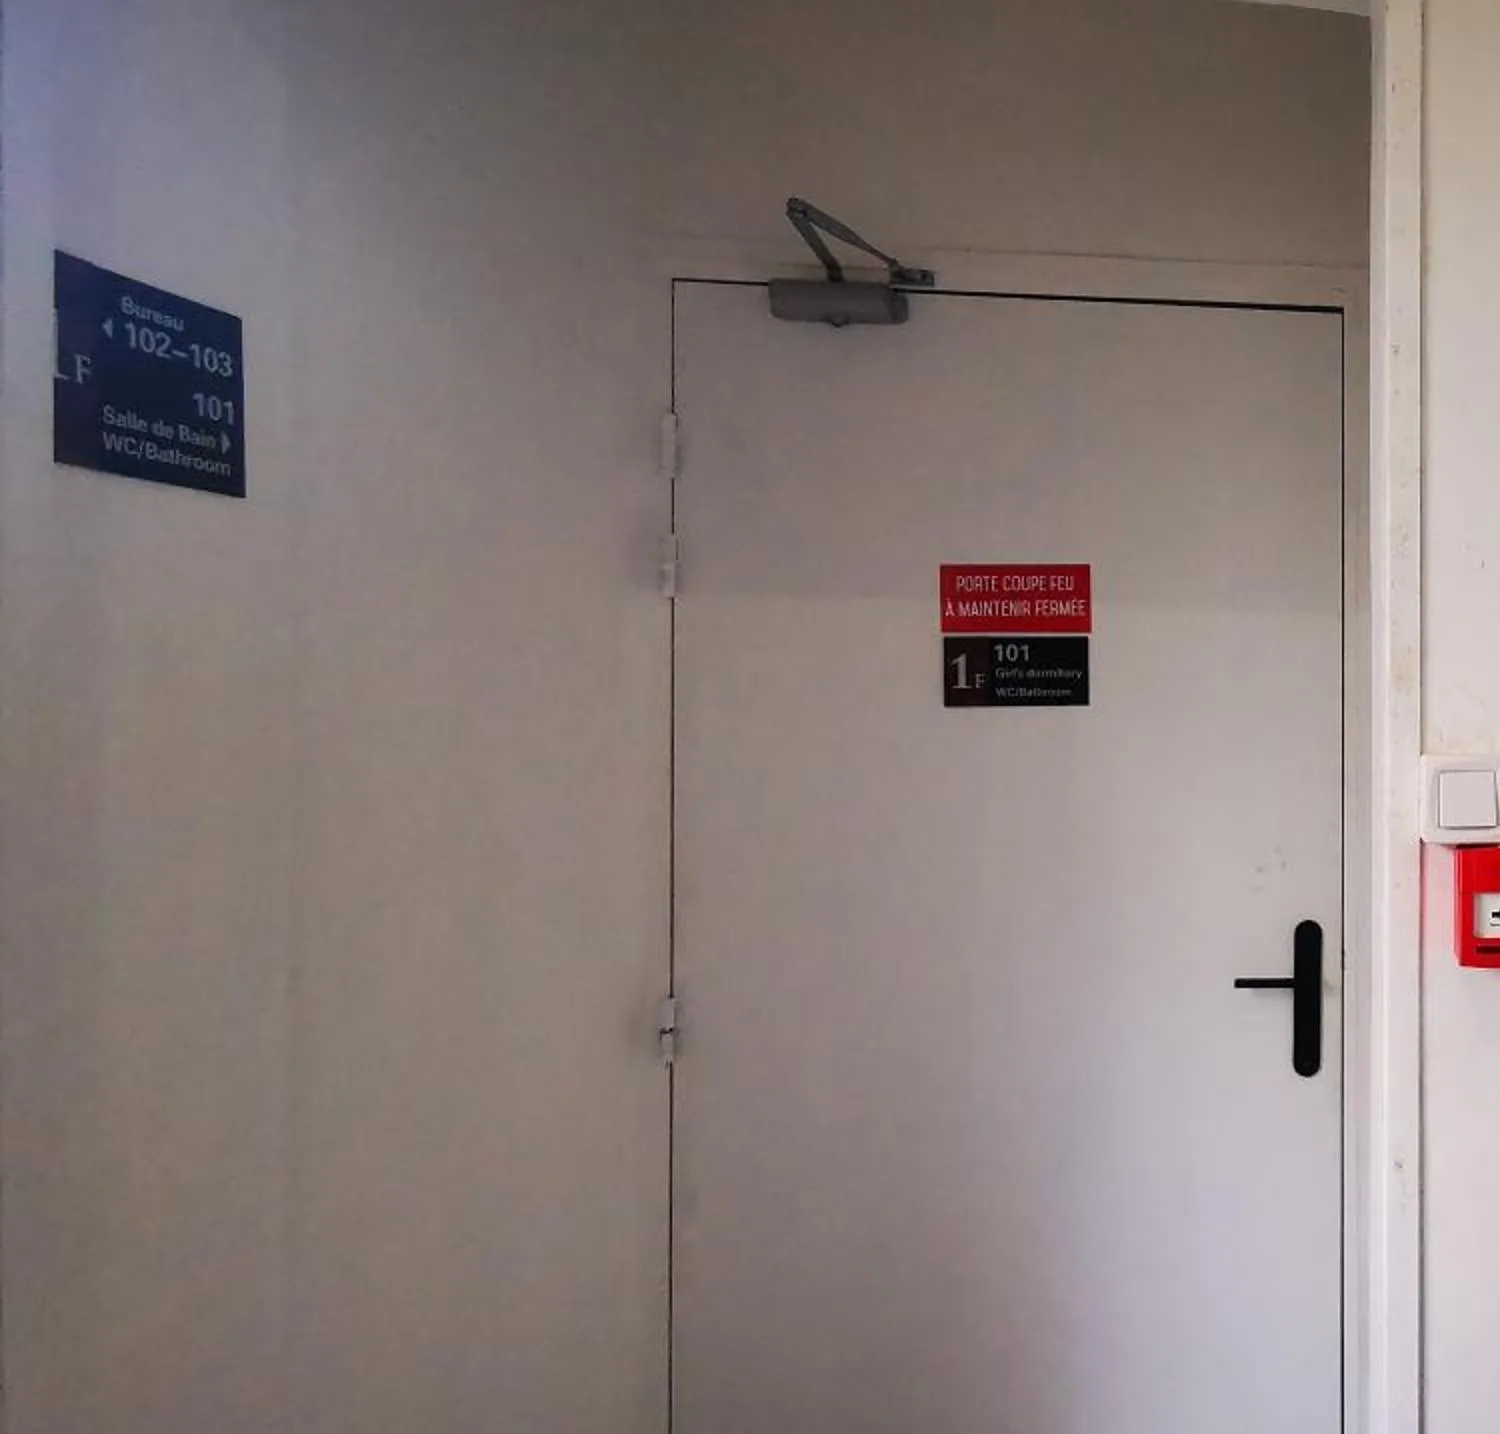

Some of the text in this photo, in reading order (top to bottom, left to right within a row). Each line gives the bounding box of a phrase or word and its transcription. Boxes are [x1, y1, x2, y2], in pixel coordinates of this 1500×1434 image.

[121, 296, 185, 331] Bureau
[193, 393, 234, 425] 101
[103, 404, 217, 448] Salle de Bain
[103, 432, 232, 477] WC/Bathroom
[956, 575, 1075, 592] PORTE COUPE FEU
[958, 599, 1032, 617] MAINTENIR
[1035, 597, 1087, 617] FERMÉE
[993, 644, 1030, 662] 101
